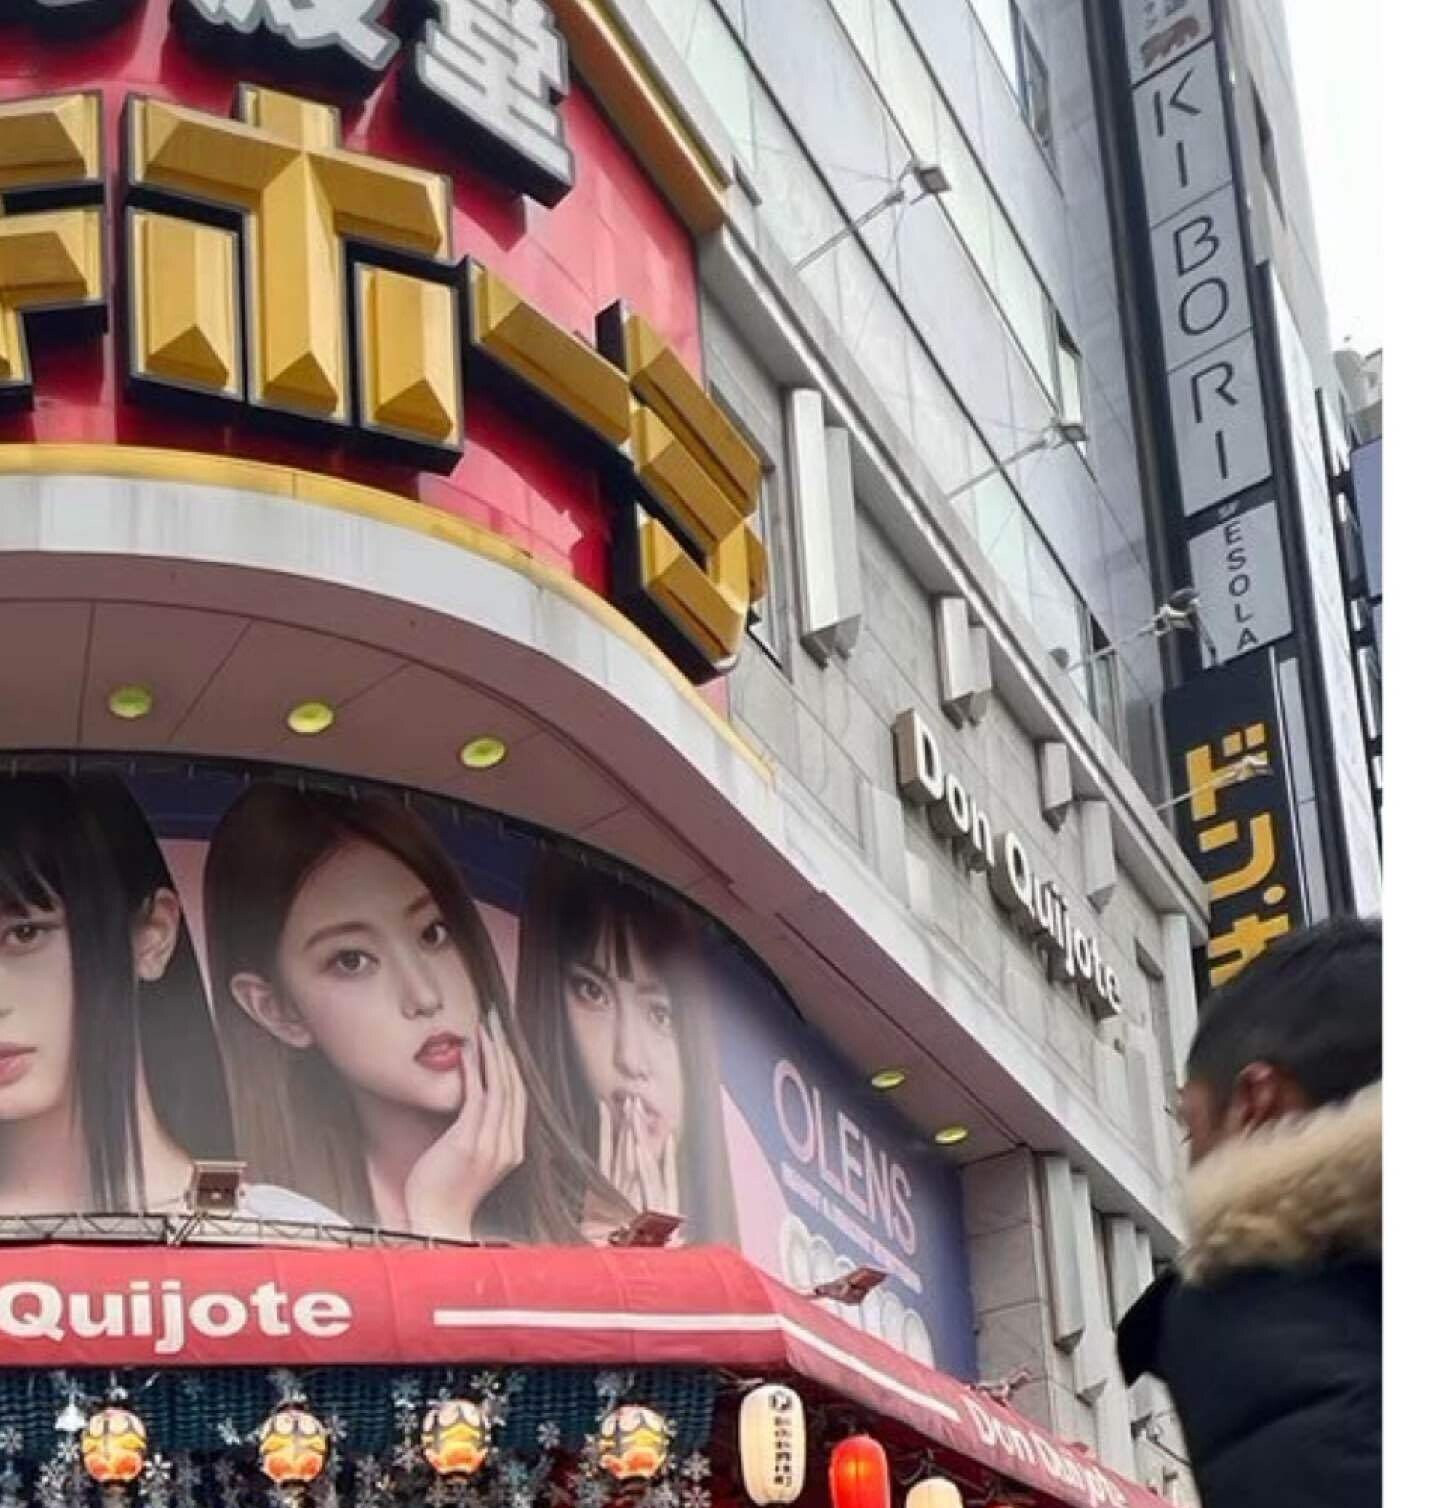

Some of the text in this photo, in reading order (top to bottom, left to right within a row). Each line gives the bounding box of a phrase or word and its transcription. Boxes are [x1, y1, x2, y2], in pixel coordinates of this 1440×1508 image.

[1153, 68, 1238, 481] KIBORI
[915, 716, 1123, 1014] Don Quijote
[774, 1058, 919, 1257] OLENS
